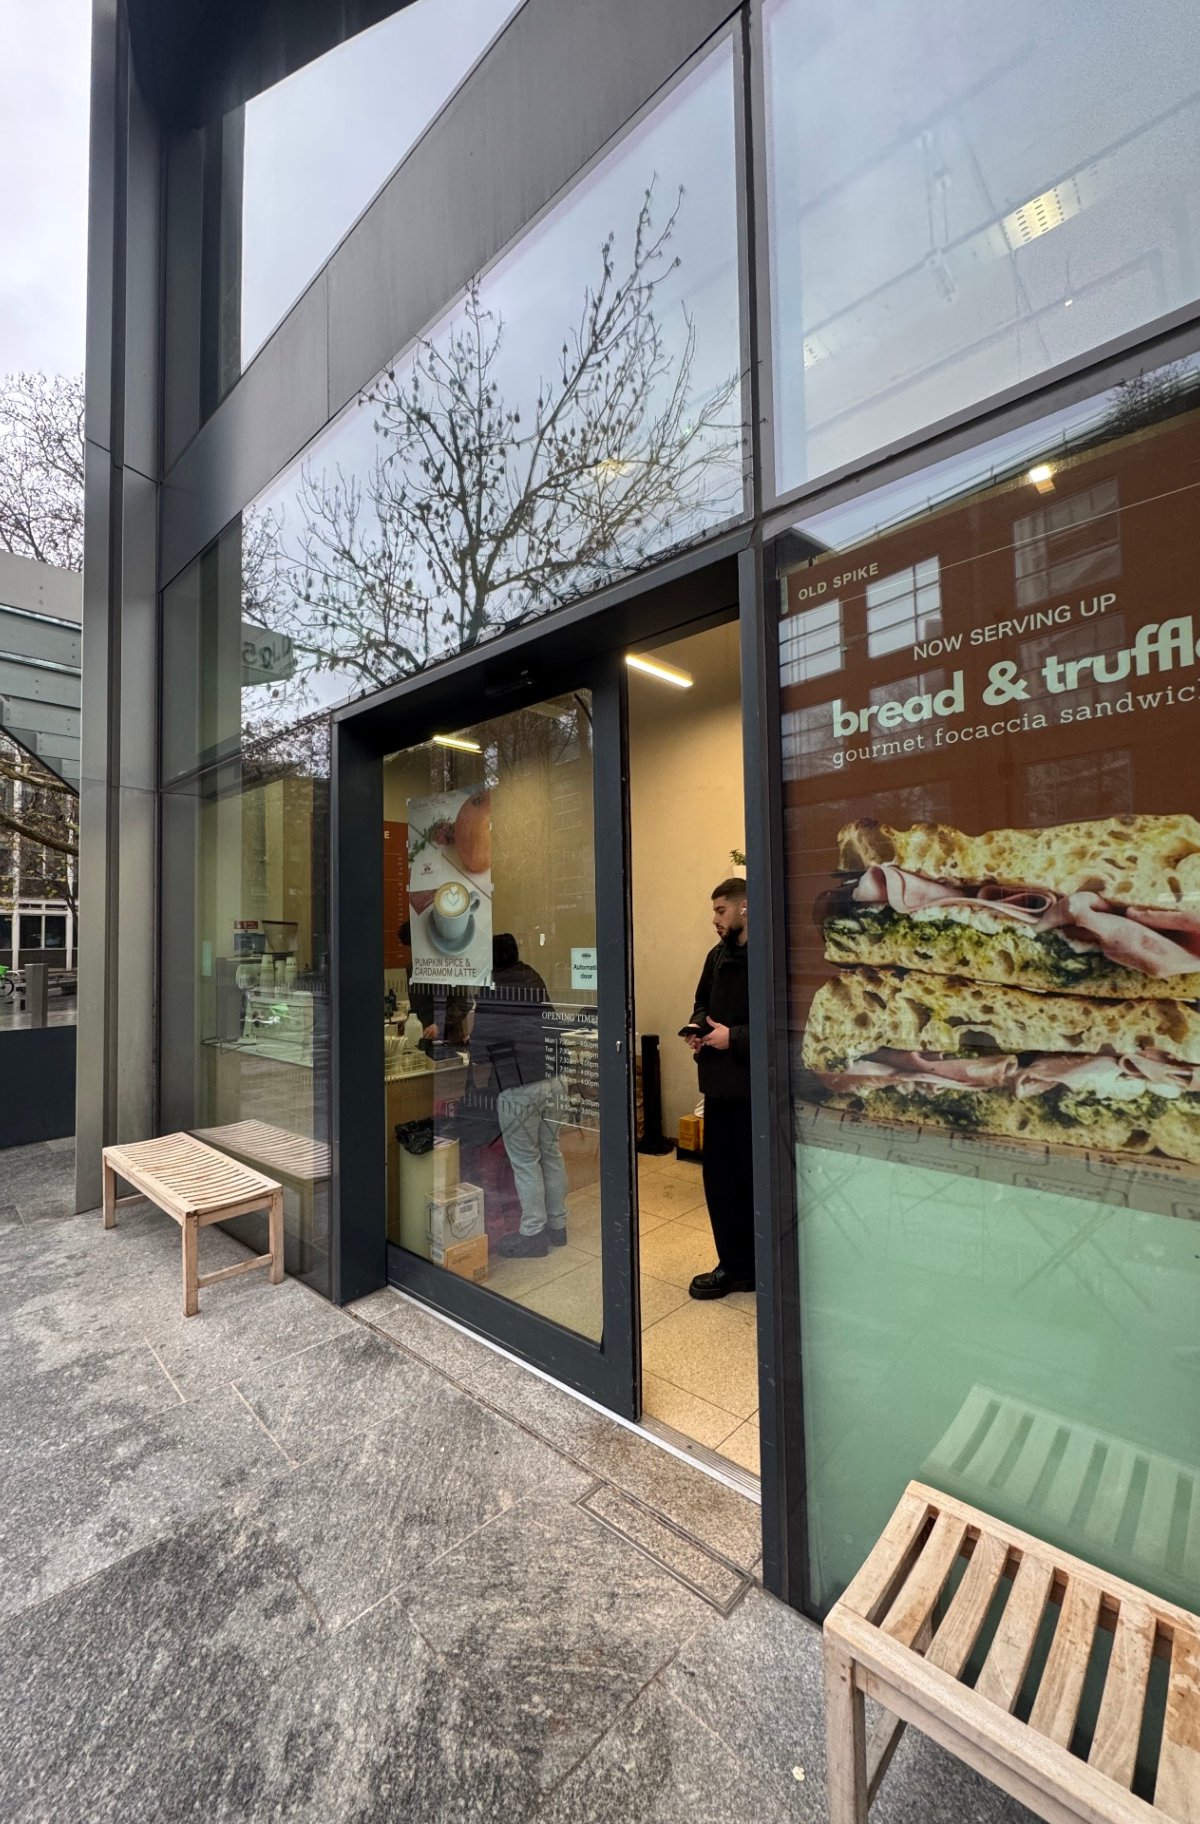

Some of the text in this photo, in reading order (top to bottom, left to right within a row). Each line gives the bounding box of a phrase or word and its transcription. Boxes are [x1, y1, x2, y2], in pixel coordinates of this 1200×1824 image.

[798, 562, 880, 601] OLD SPIKE
[913, 593, 1117, 660] NOW SERVING UP
[833, 615, 1200, 738] bread & truffl
[832, 678, 1200, 769] gourmet focaccia sandwic
[415, 957, 443, 968] PUMPKIN
[444, 958, 464, 968] SPICE
[415, 967, 477, 978] CARDAMOM LATTE
[541, 1011, 575, 1022] OPENING
